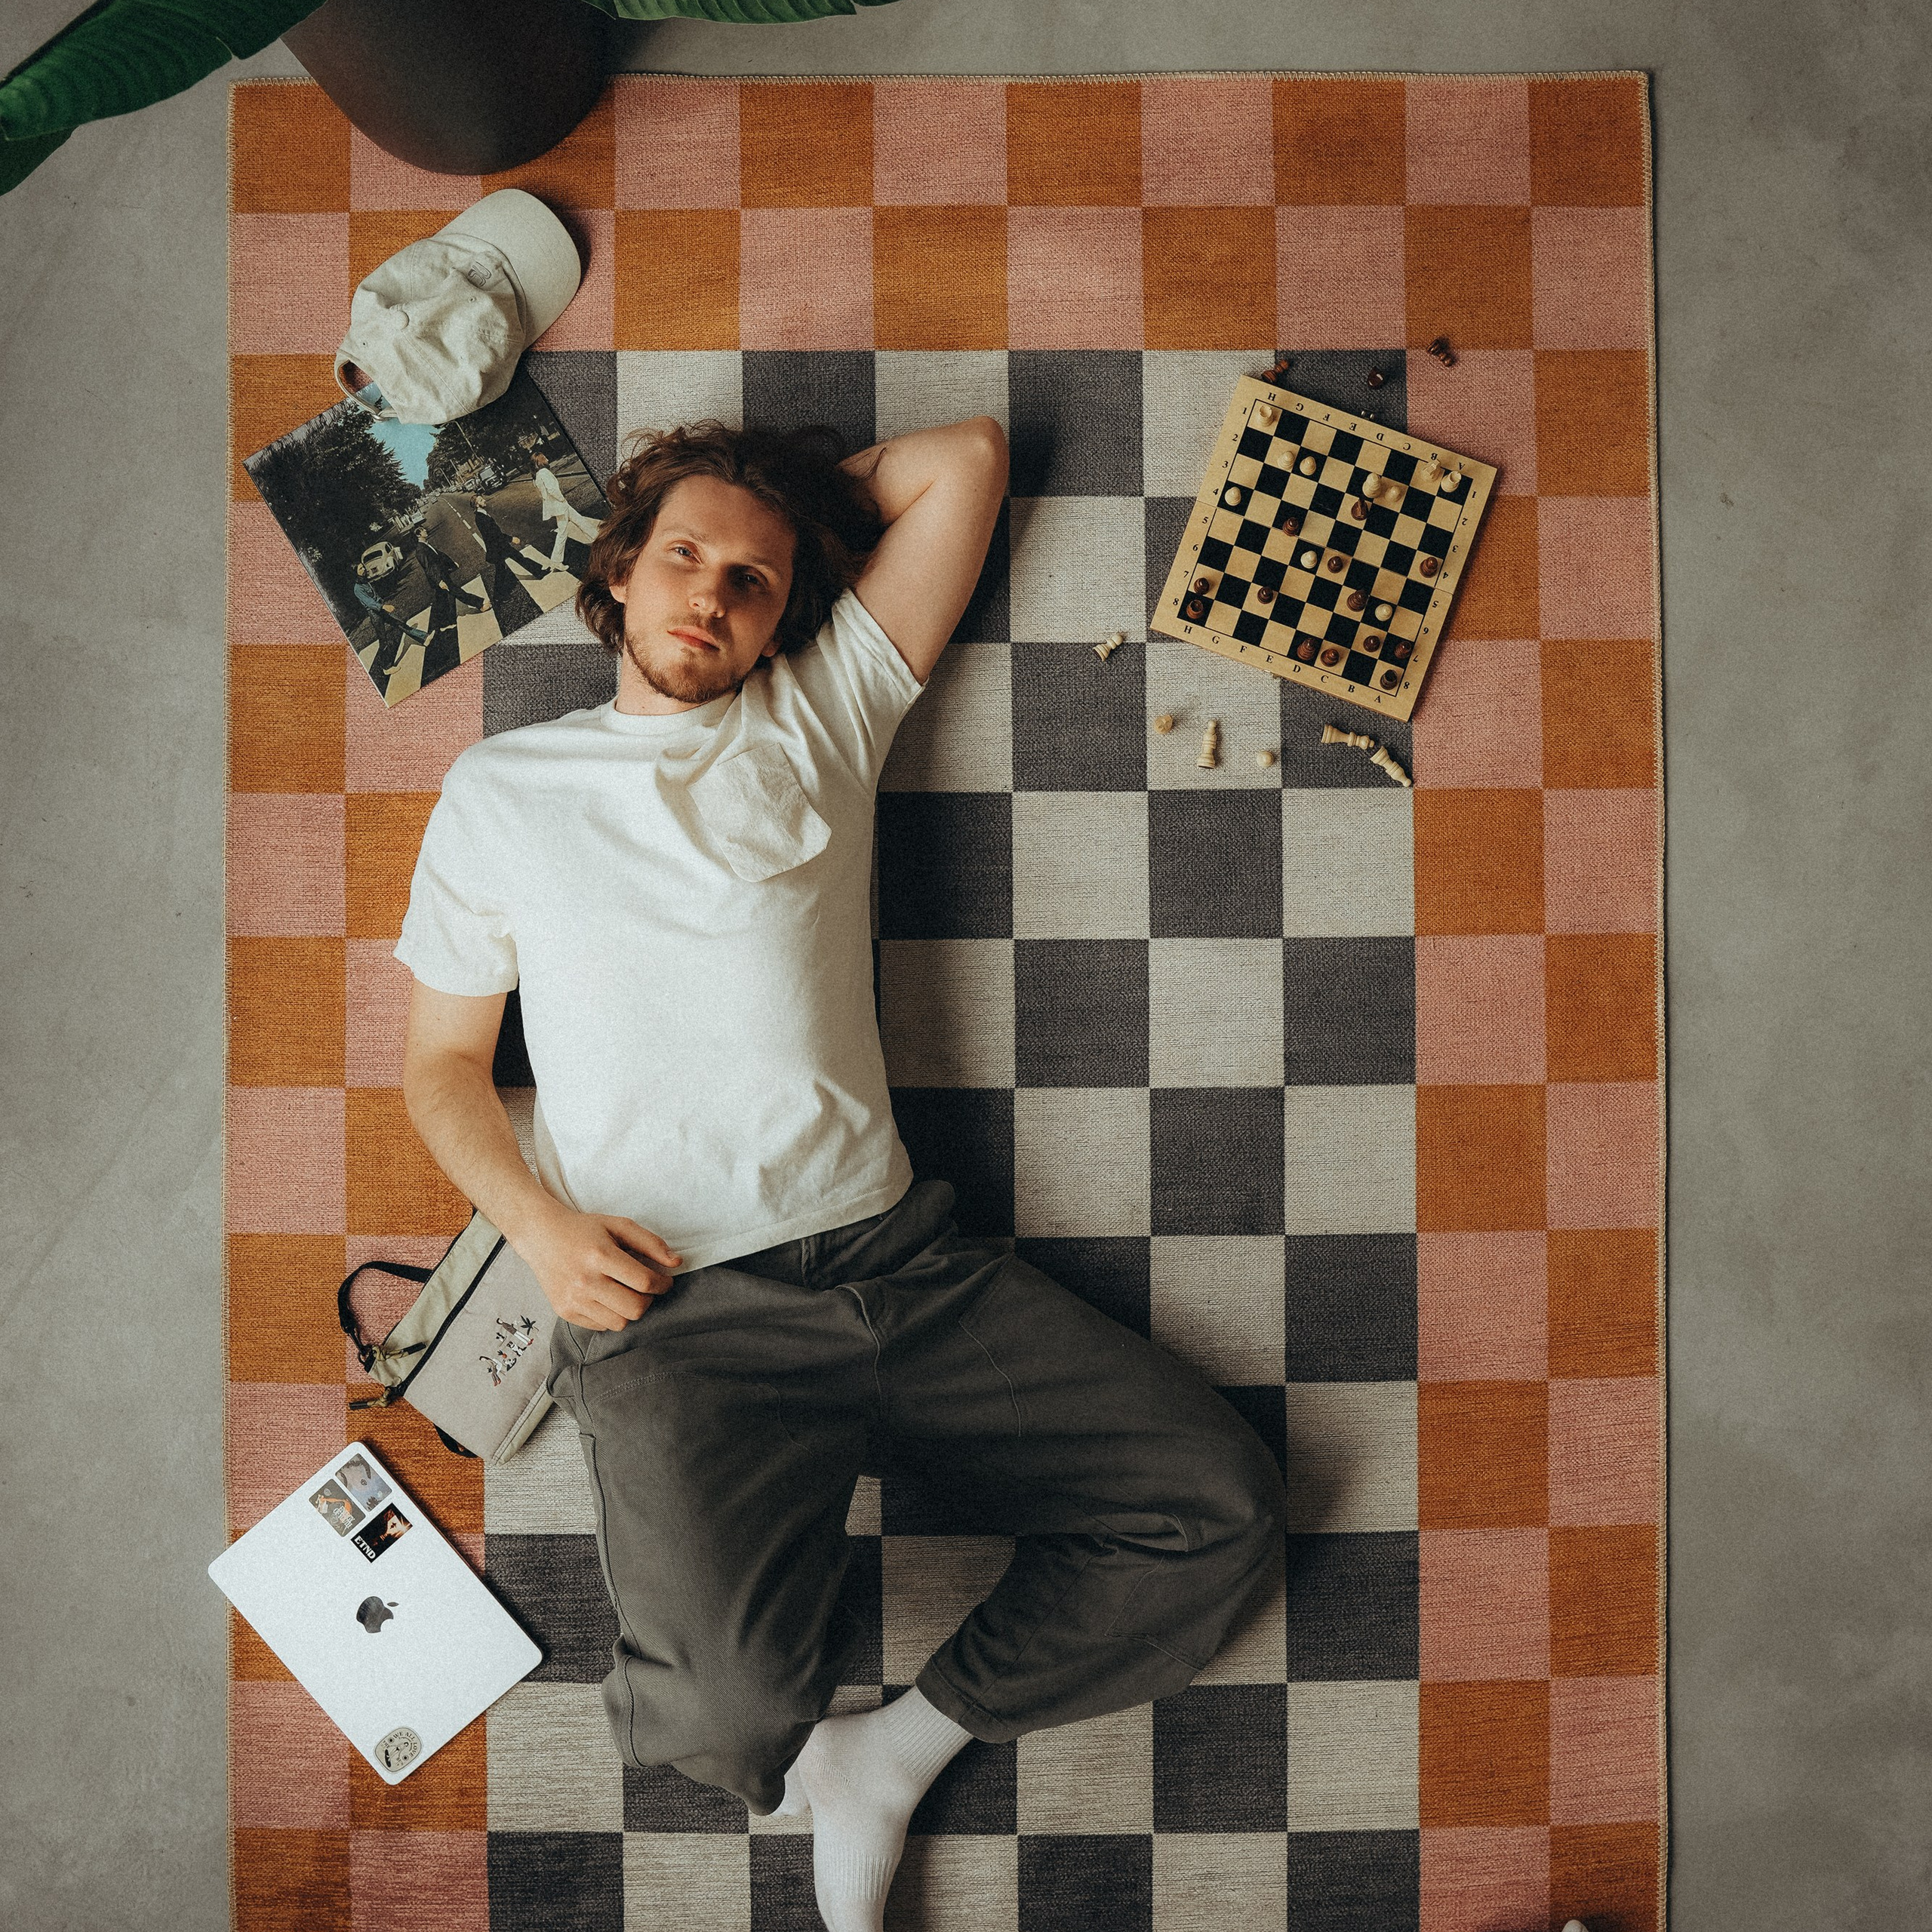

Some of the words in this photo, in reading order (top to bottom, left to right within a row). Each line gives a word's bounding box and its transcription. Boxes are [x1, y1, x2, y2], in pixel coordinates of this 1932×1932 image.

[1267, 392, 1277, 401] H
[1242, 407, 1247, 415] 1
[1295, 402, 1304, 411] G
[1322, 413, 1331, 422] F
[1349, 422, 1358, 432] E
[1232, 433, 1238, 442] 2
[1376, 432, 1384, 441] D
[1402, 442, 1411, 451] C
[1430, 452, 1438, 461] B
[1222, 460, 1229, 469] 3
[1457, 462, 1466, 471] A
[1212, 488, 1219, 496] 4
[1201, 516, 1209, 525] 5
[1192, 543, 1199, 552] 6
[1183, 570, 1189, 578] 7
[1403, 681, 1411, 690] 8
[1413, 654, 1419, 663] 7
[1423, 626, 1429, 635] 6
[1432, 600, 1439, 608] 5
[1442, 571, 1449, 580] 4
[1452, 545, 1459, 553] 3
[1461, 517, 1469, 526] 2
[1472, 491, 1477, 499] 1
[1172, 598, 1180, 606] 8
[1183, 625, 1193, 634] H
[1211, 635, 1220, 645] G
[1239, 645, 1247, 654] F
[1266, 654, 1275, 664] E
[1292, 664, 1301, 673] D
[1321, 675, 1329, 684] C
[1347, 684, 1355, 693] B
[1374, 695, 1381, 703] A
[354, 1535, 376, 1559] ETND
[405, 1732, 415, 1741] ALL
[409, 1743, 418, 1758] LOVE
